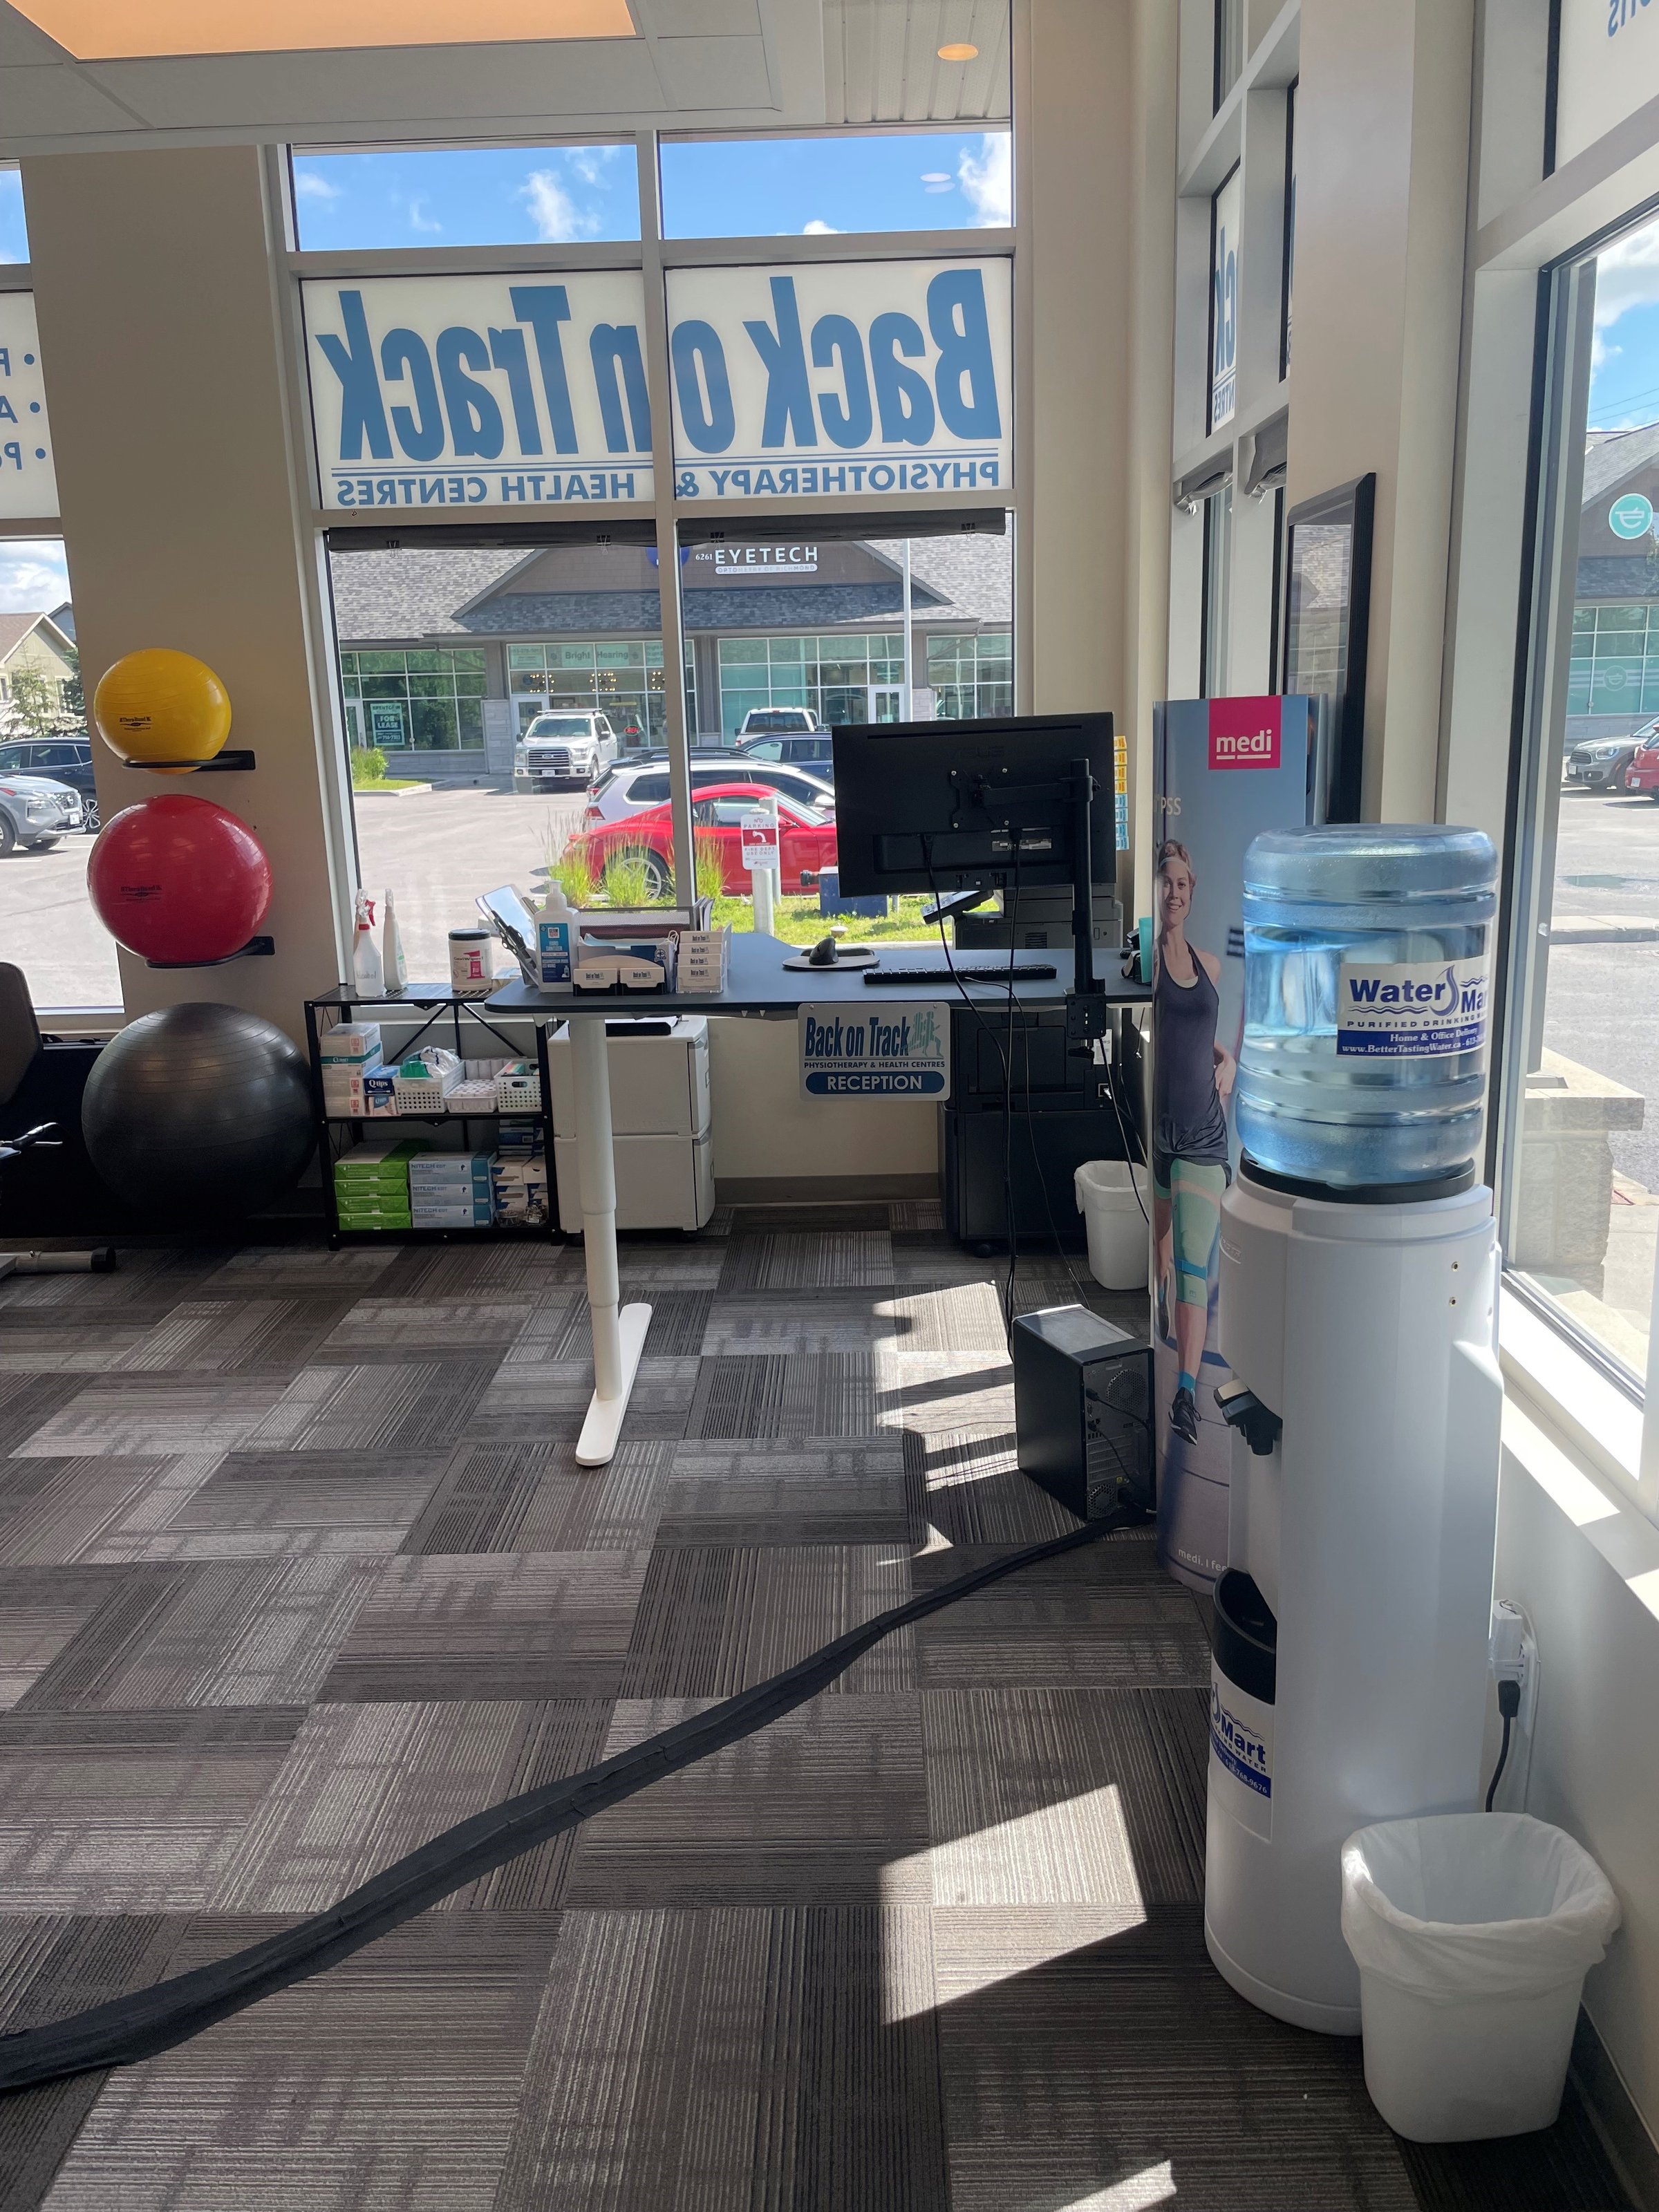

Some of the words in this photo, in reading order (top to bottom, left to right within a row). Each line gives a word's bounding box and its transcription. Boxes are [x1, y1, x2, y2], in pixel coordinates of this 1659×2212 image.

[715, 547, 818, 564] EYETECH
[565, 651, 590, 660] Bright
[597, 650, 628, 659] Hearing
[1217, 729, 1272, 753] medi
[1349, 979, 1446, 1003] Water
[1423, 1015, 1475, 1027] DRINKING
[805, 1017, 844, 1057] Back
[845, 1026, 865, 1057] on
[869, 1016, 911, 1057] Track
[1389, 1033, 1418, 1042] Home
[1421, 1033, 1428, 1041] &
[1431, 1031, 1455, 1040] Office
[1342, 1041, 1461, 1053] www.BetterTastingWater.ca
[827, 1076, 921, 1090] RECEPTION
[1178, 1549, 1203, 1566] medi.
[1221, 1714, 1266, 1765] Mart
[1235, 1748, 1266, 1772] WATER
